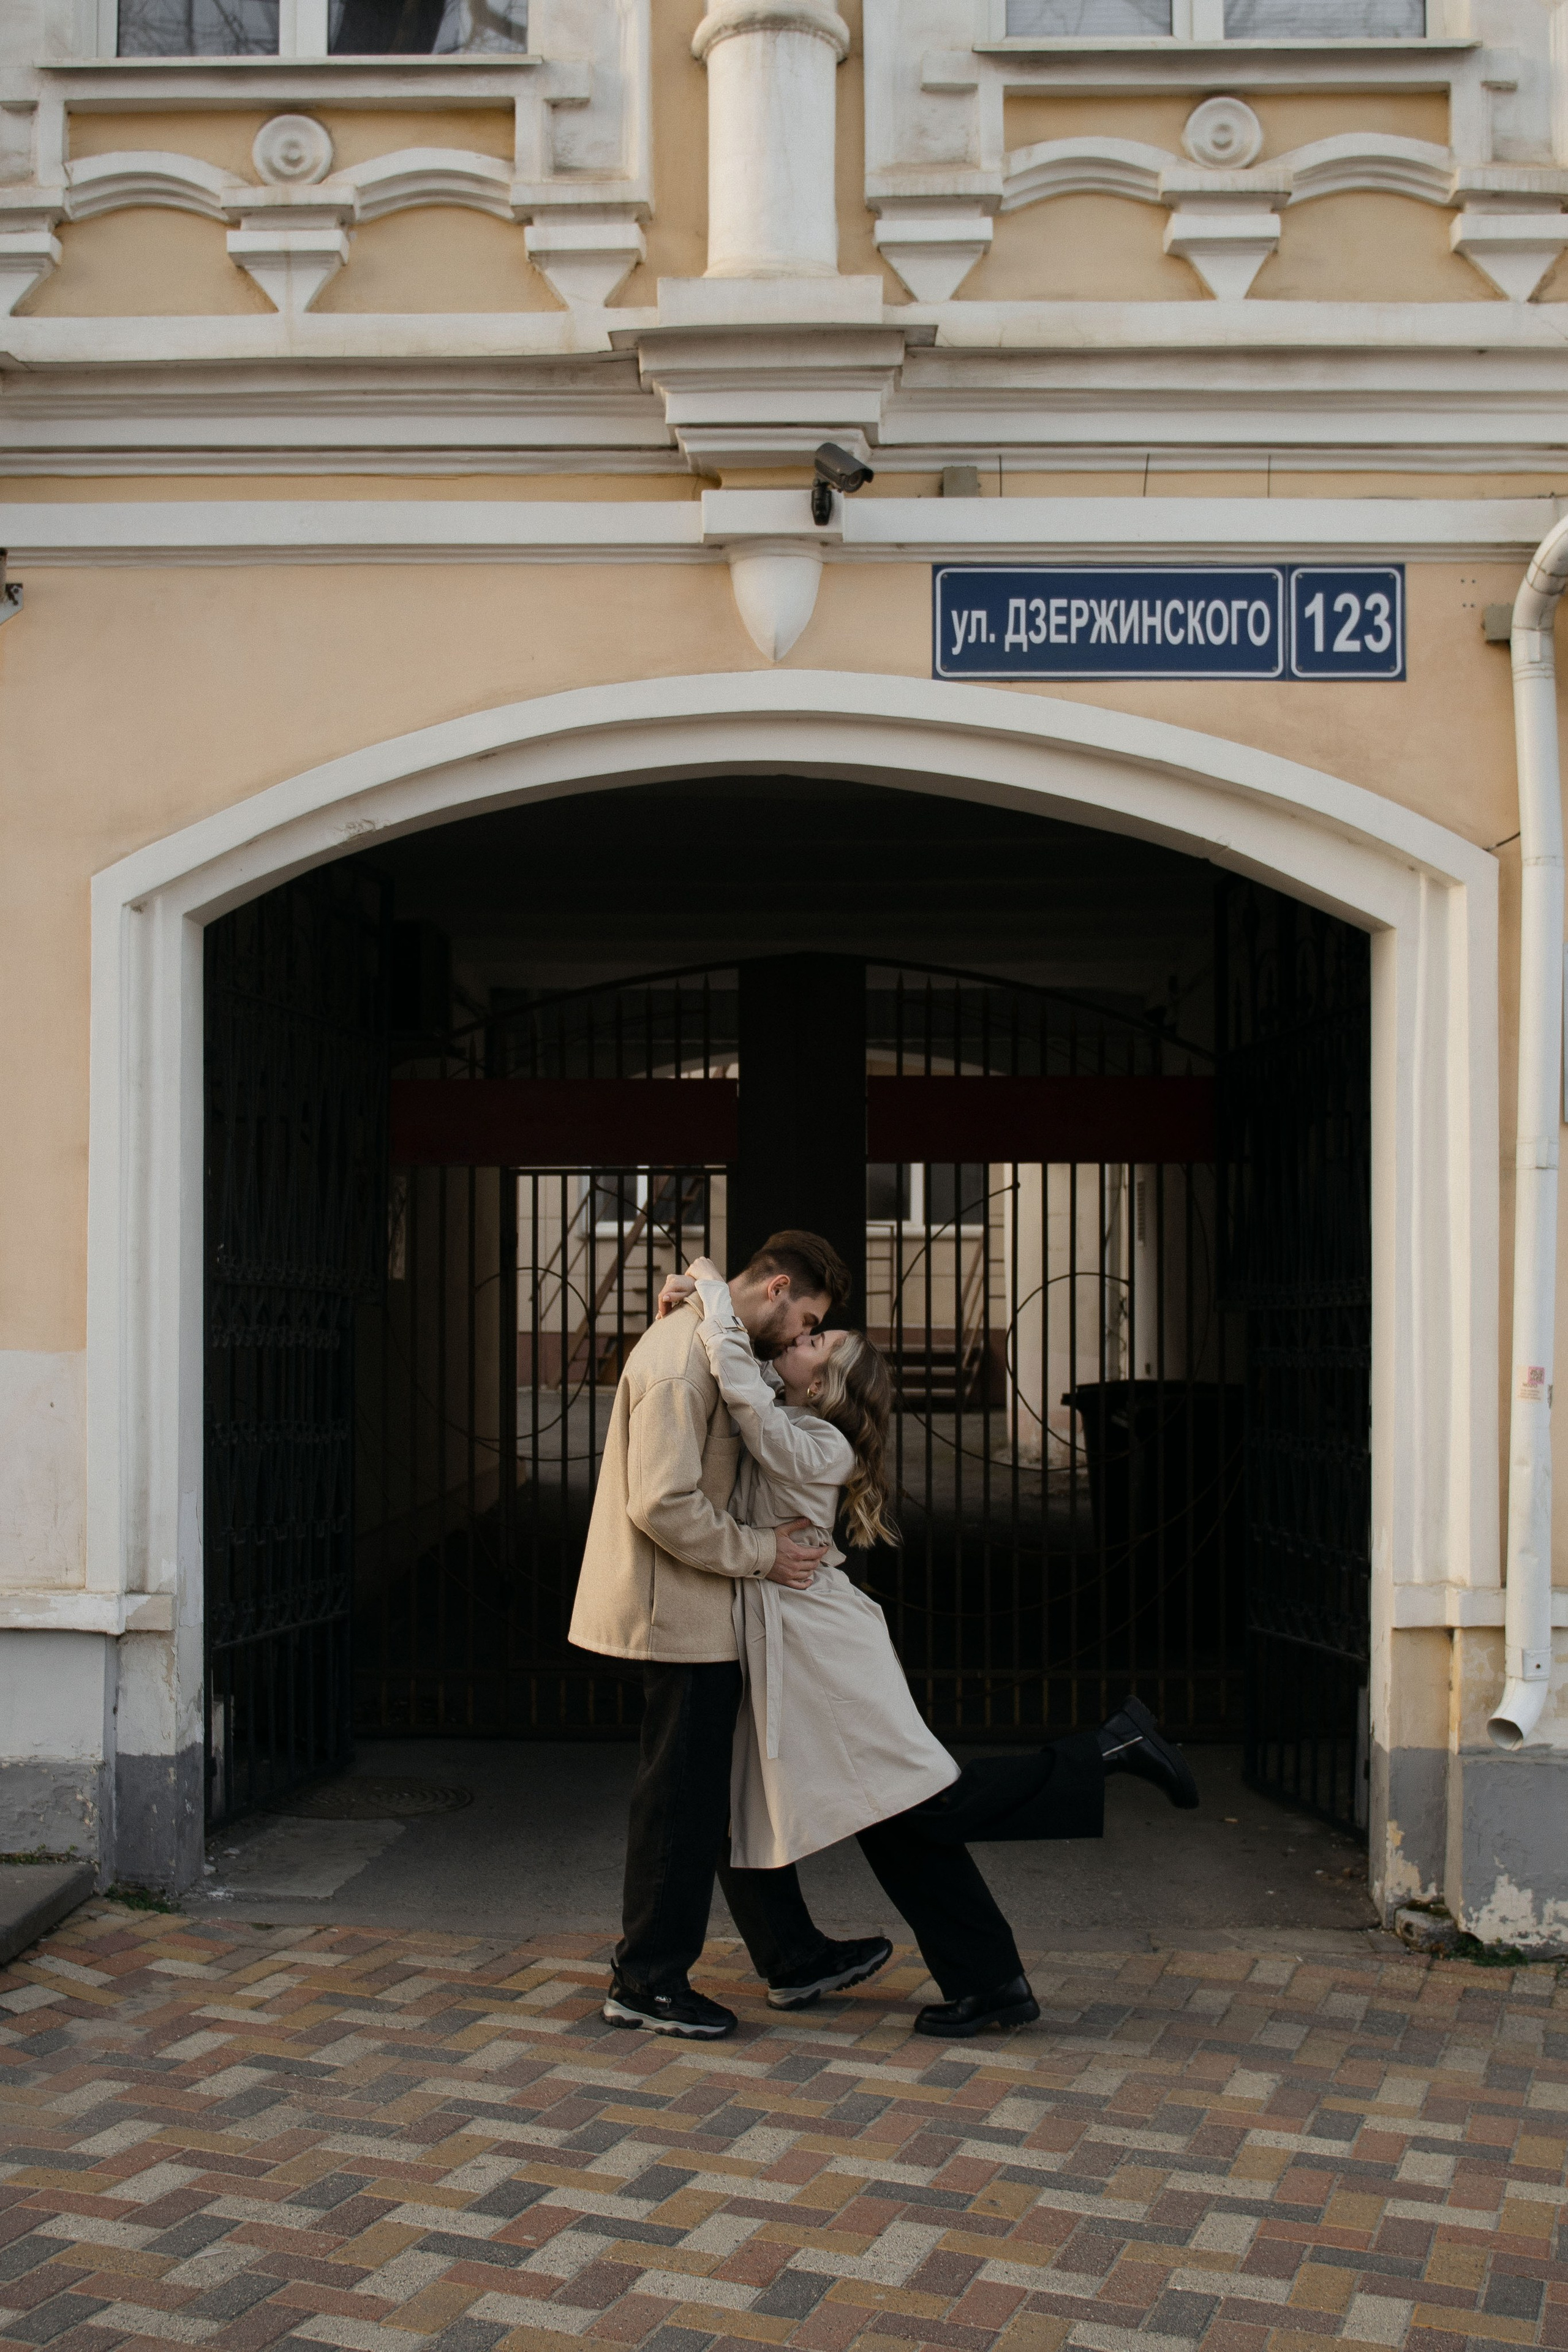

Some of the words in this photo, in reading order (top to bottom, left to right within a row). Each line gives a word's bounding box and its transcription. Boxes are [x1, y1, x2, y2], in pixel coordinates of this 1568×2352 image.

[951, 611, 995, 655] ул.
[1005, 598, 1271, 652] ДЗЕРЖИНСКОГО
[1305, 592, 1392, 653] 123
